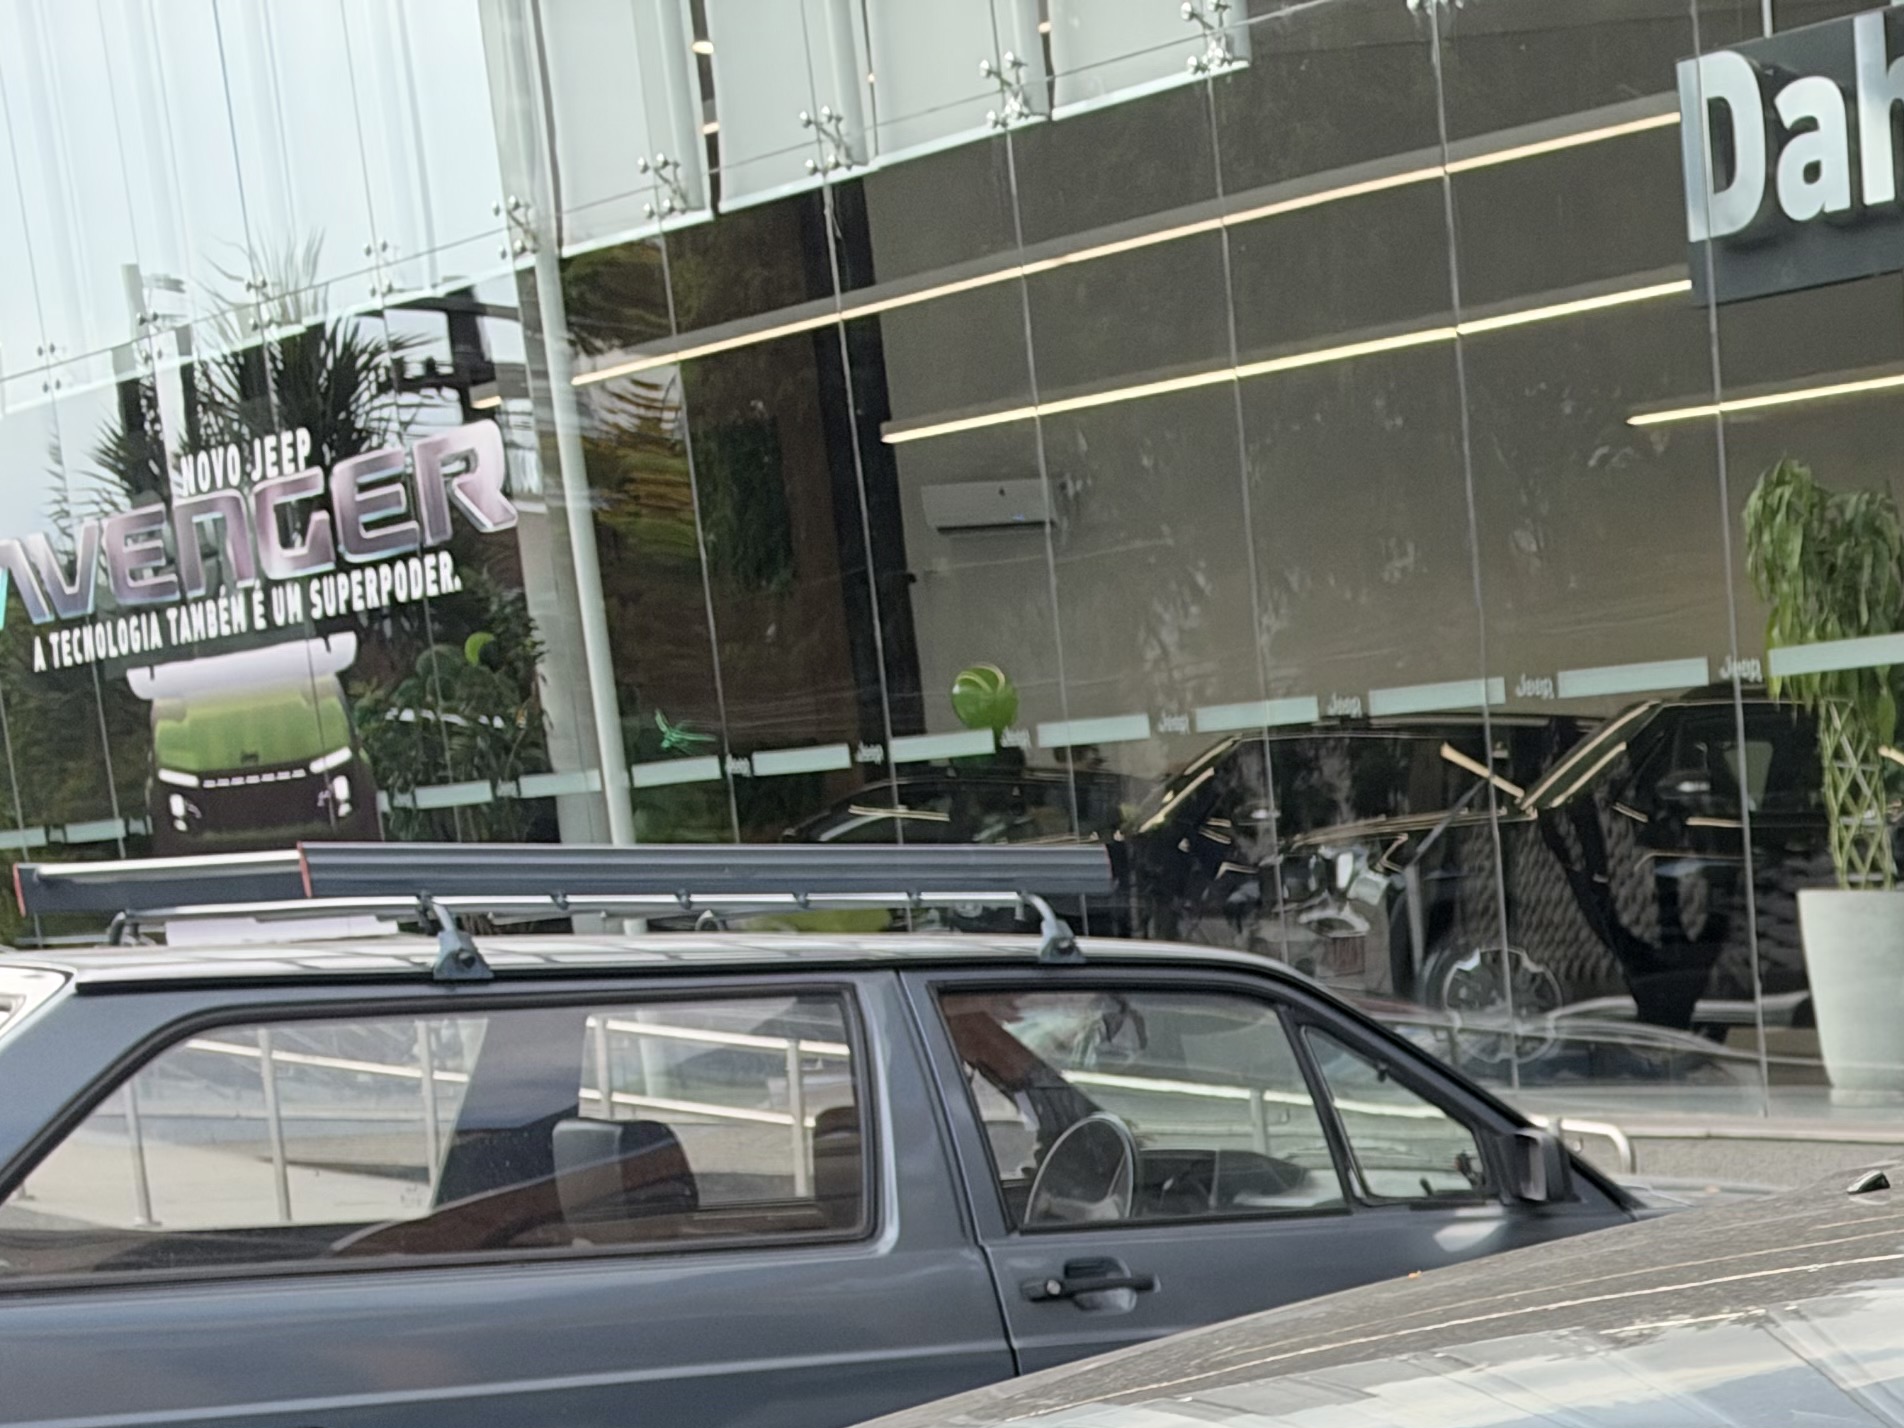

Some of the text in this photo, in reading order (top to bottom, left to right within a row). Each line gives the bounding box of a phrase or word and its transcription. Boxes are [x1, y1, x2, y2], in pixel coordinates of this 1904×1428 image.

[181, 427, 311, 496] NOVO JEEP
[34, 550, 462, 672] A TECNOLOGIA TAMBÉM É UM SUPERPODER.
[1515, 673, 1555, 701] Jeep
